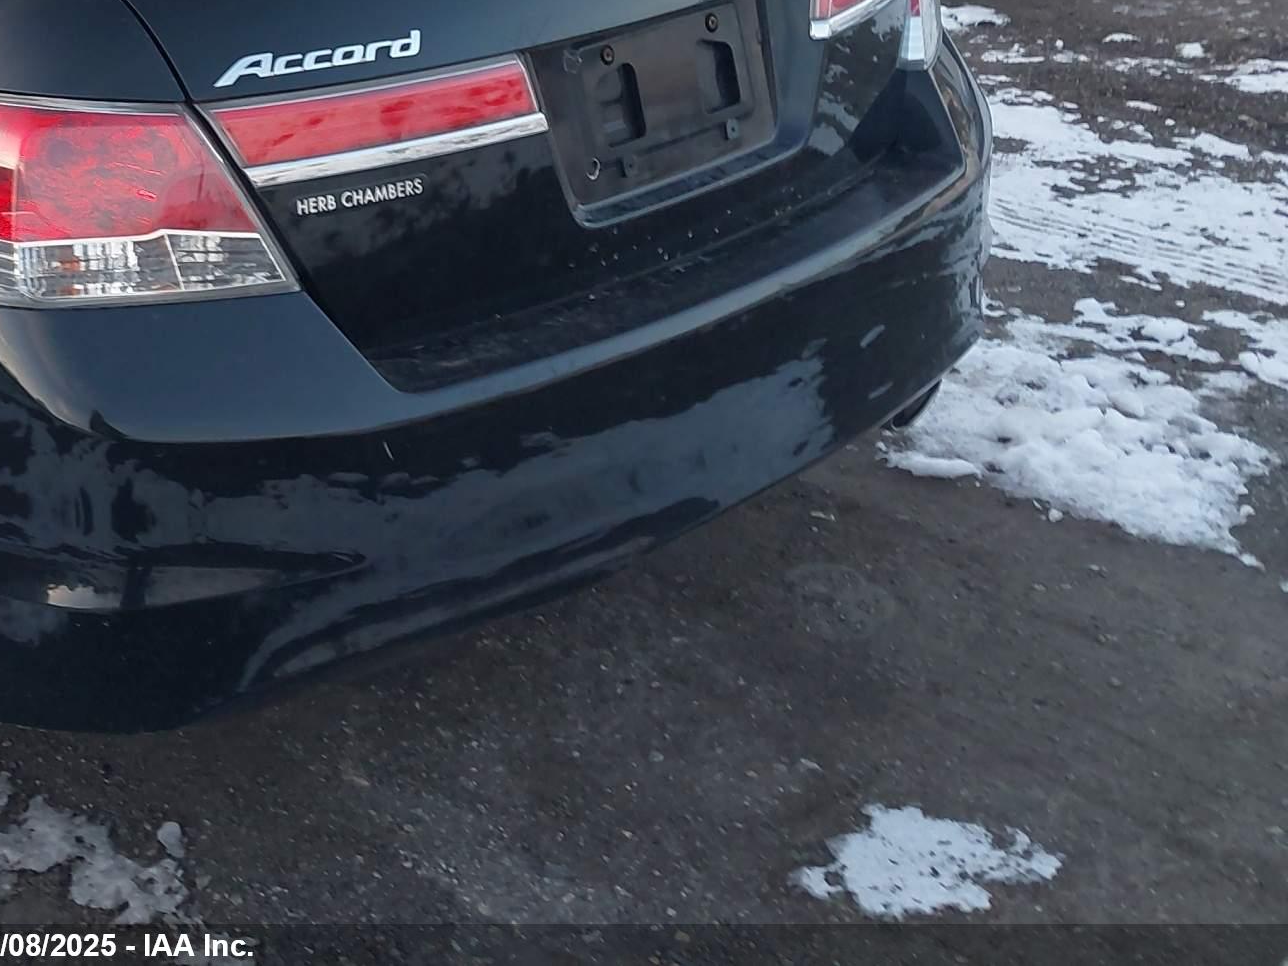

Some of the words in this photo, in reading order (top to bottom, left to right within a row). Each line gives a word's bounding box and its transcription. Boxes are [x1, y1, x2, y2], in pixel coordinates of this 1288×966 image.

[214, 30, 421, 88] Accord
[296, 195, 337, 216] HERB
[340, 178, 424, 208] CHAMBERS
